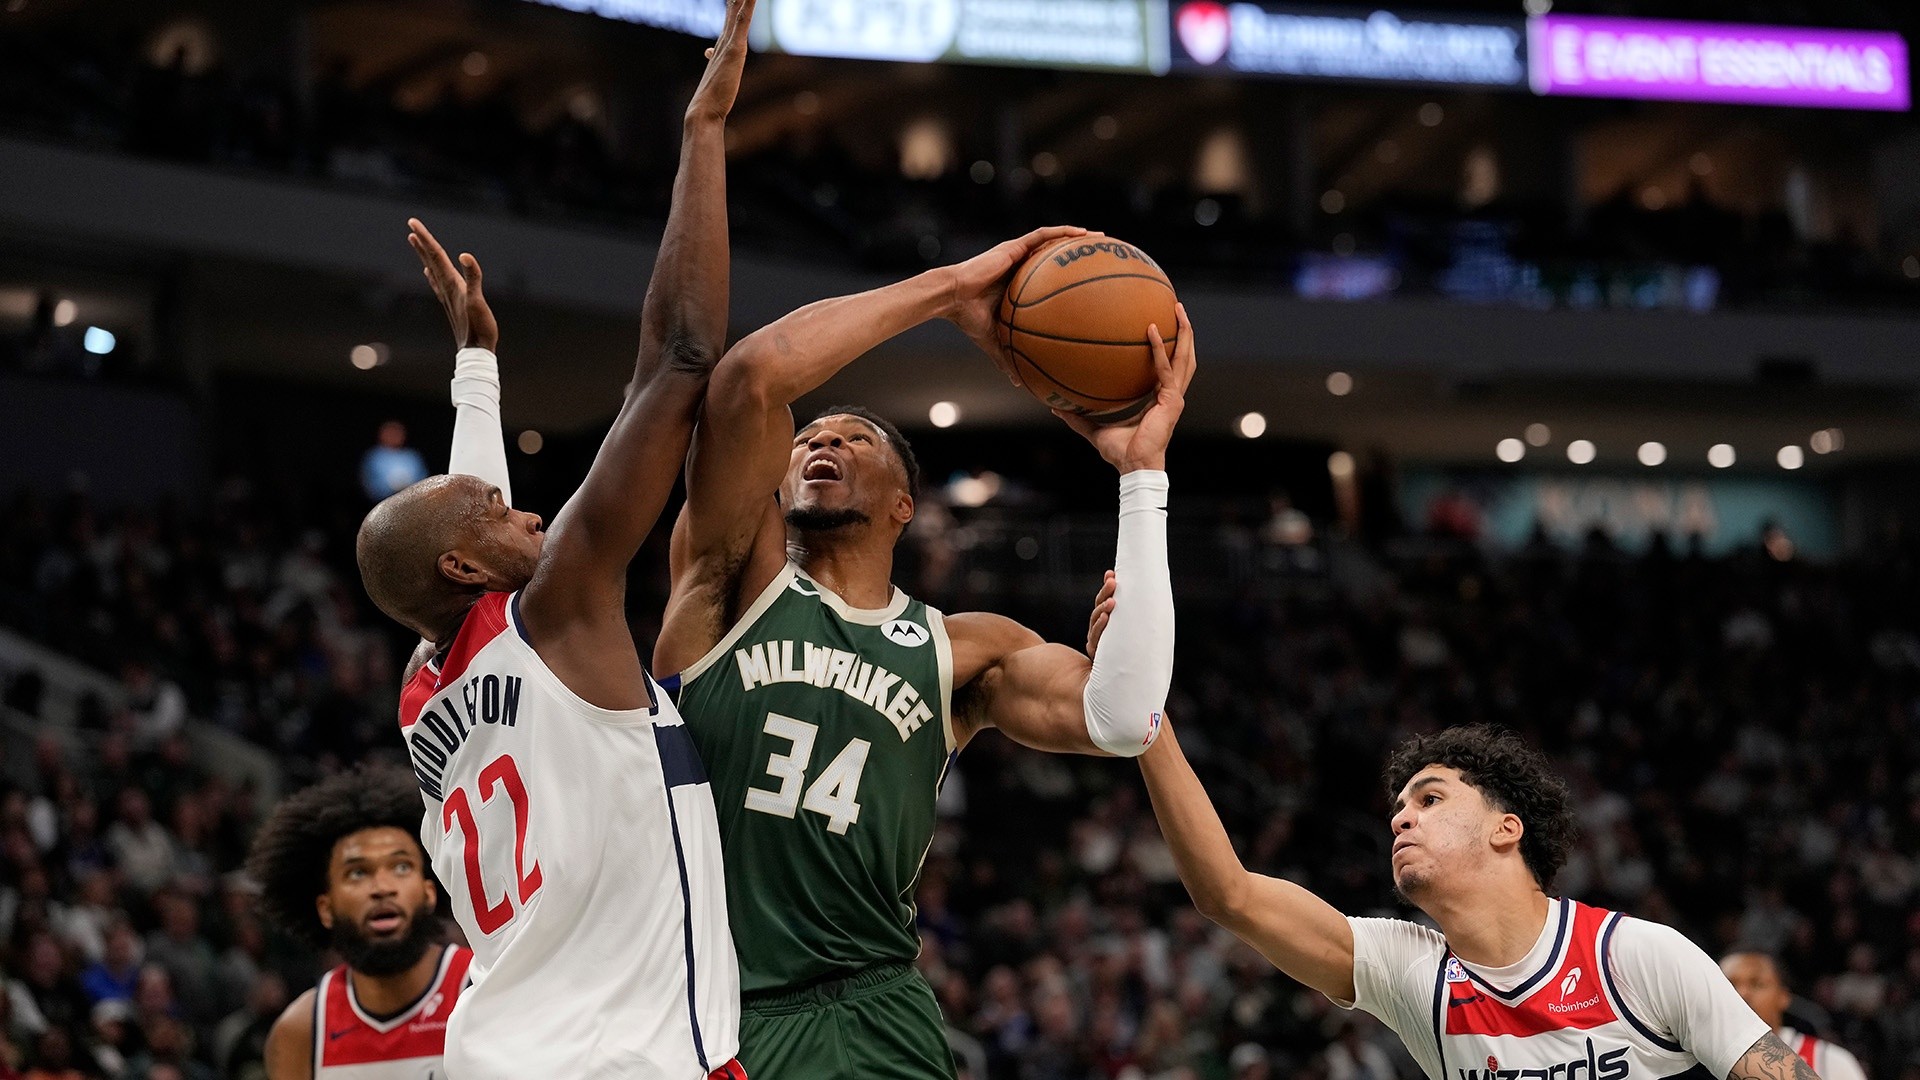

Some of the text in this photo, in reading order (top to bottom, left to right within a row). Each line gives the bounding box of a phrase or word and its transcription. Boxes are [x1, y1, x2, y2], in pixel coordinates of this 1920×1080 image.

[1586, 34, 1697, 82] EVENT
[1702, 39, 1892, 92] ESSENTIALS
[735, 640, 934, 743] MILWAUKEE
[744, 711, 871, 836] 34
[443, 754, 543, 935] 22
[1548, 993, 1600, 1013] Robinhood
